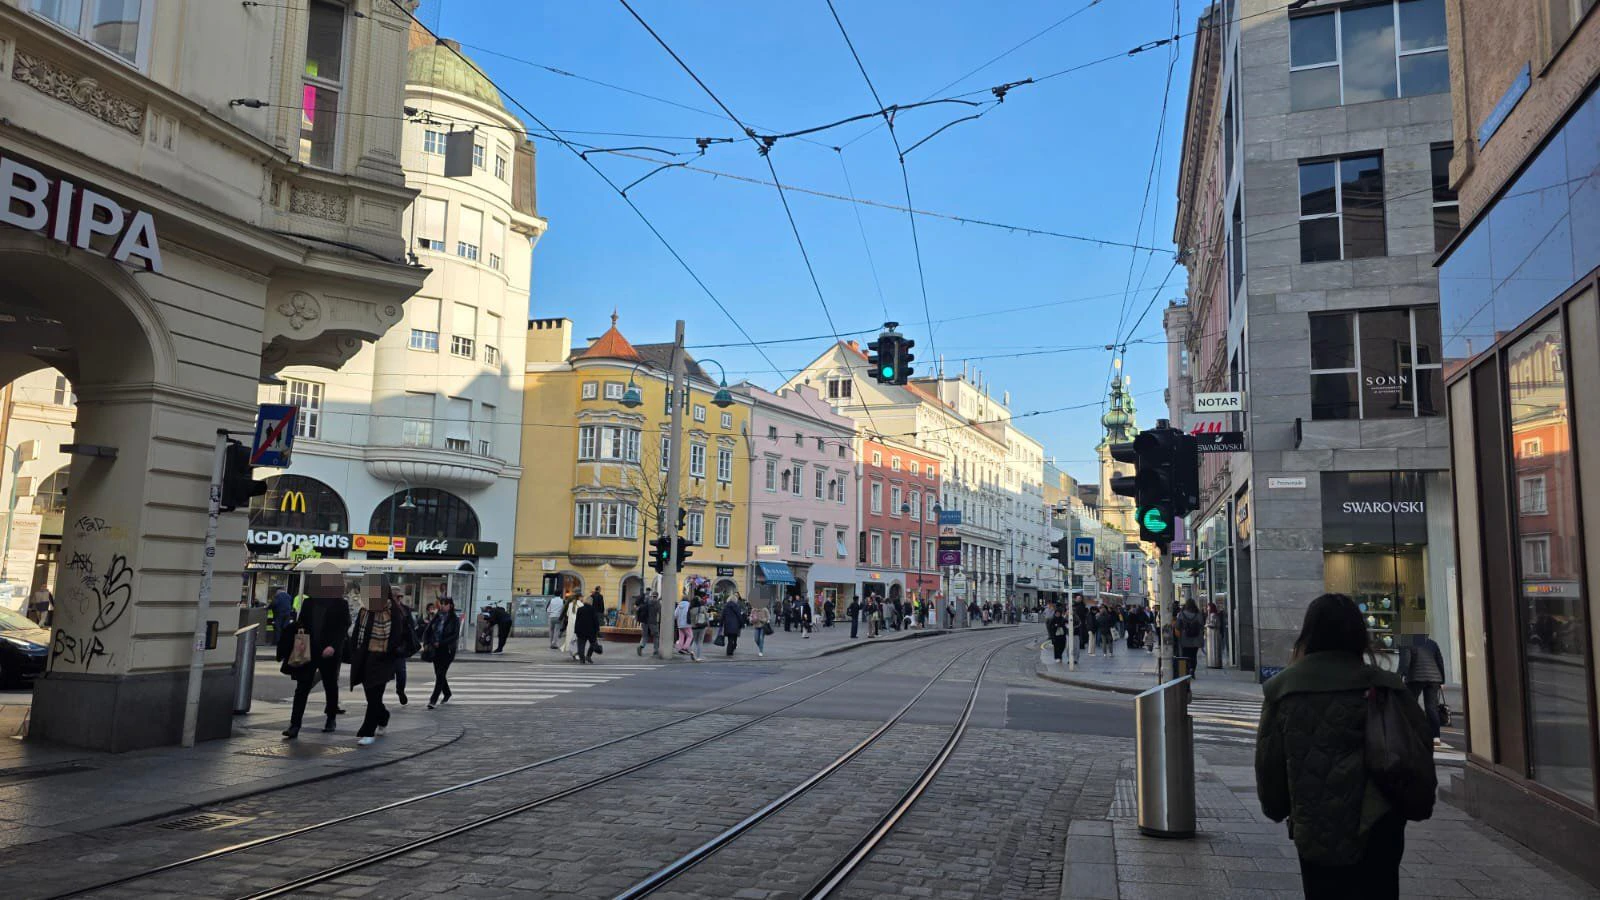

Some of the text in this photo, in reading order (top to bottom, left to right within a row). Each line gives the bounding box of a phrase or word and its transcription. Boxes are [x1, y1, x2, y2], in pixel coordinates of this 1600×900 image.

[0, 156, 163, 273] BIPA
[1366, 375, 1408, 385] SONN
[1198, 398, 1238, 407] NOTAR
[1190, 421, 1222, 434] HM
[1197, 444, 1242, 452] SWAROVSKI
[1343, 501, 1424, 513] SWAROVSKI
